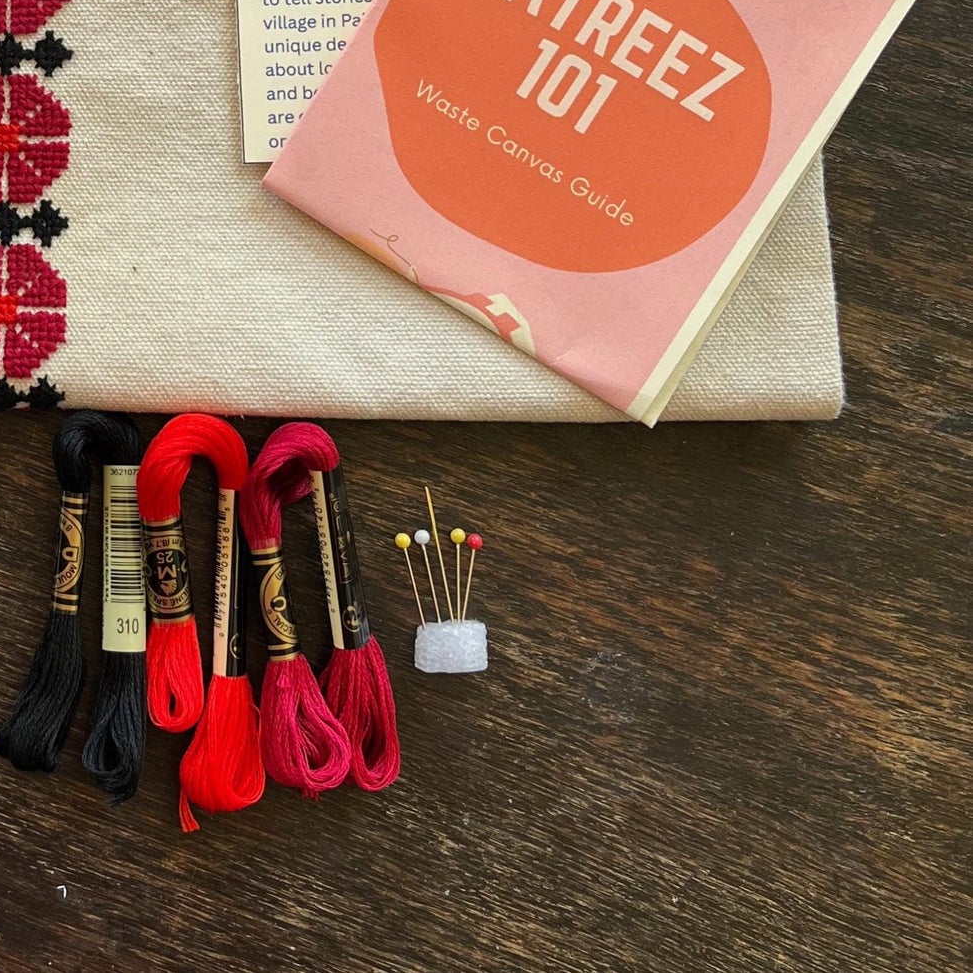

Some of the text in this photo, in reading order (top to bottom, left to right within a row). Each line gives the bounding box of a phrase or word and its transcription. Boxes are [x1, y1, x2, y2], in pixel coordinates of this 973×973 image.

[263, 12, 365, 33] village in Pa
[264, 37, 347, 56] unique de
[266, 62, 314, 77] about
[266, 86, 297, 101] and
[516, 38, 618, 134] 101
[267, 112, 294, 124] are
[416, 79, 634, 226] Waste Canvas Guide
[156, 550, 174, 564] 25
[116, 617, 139, 635] 310
